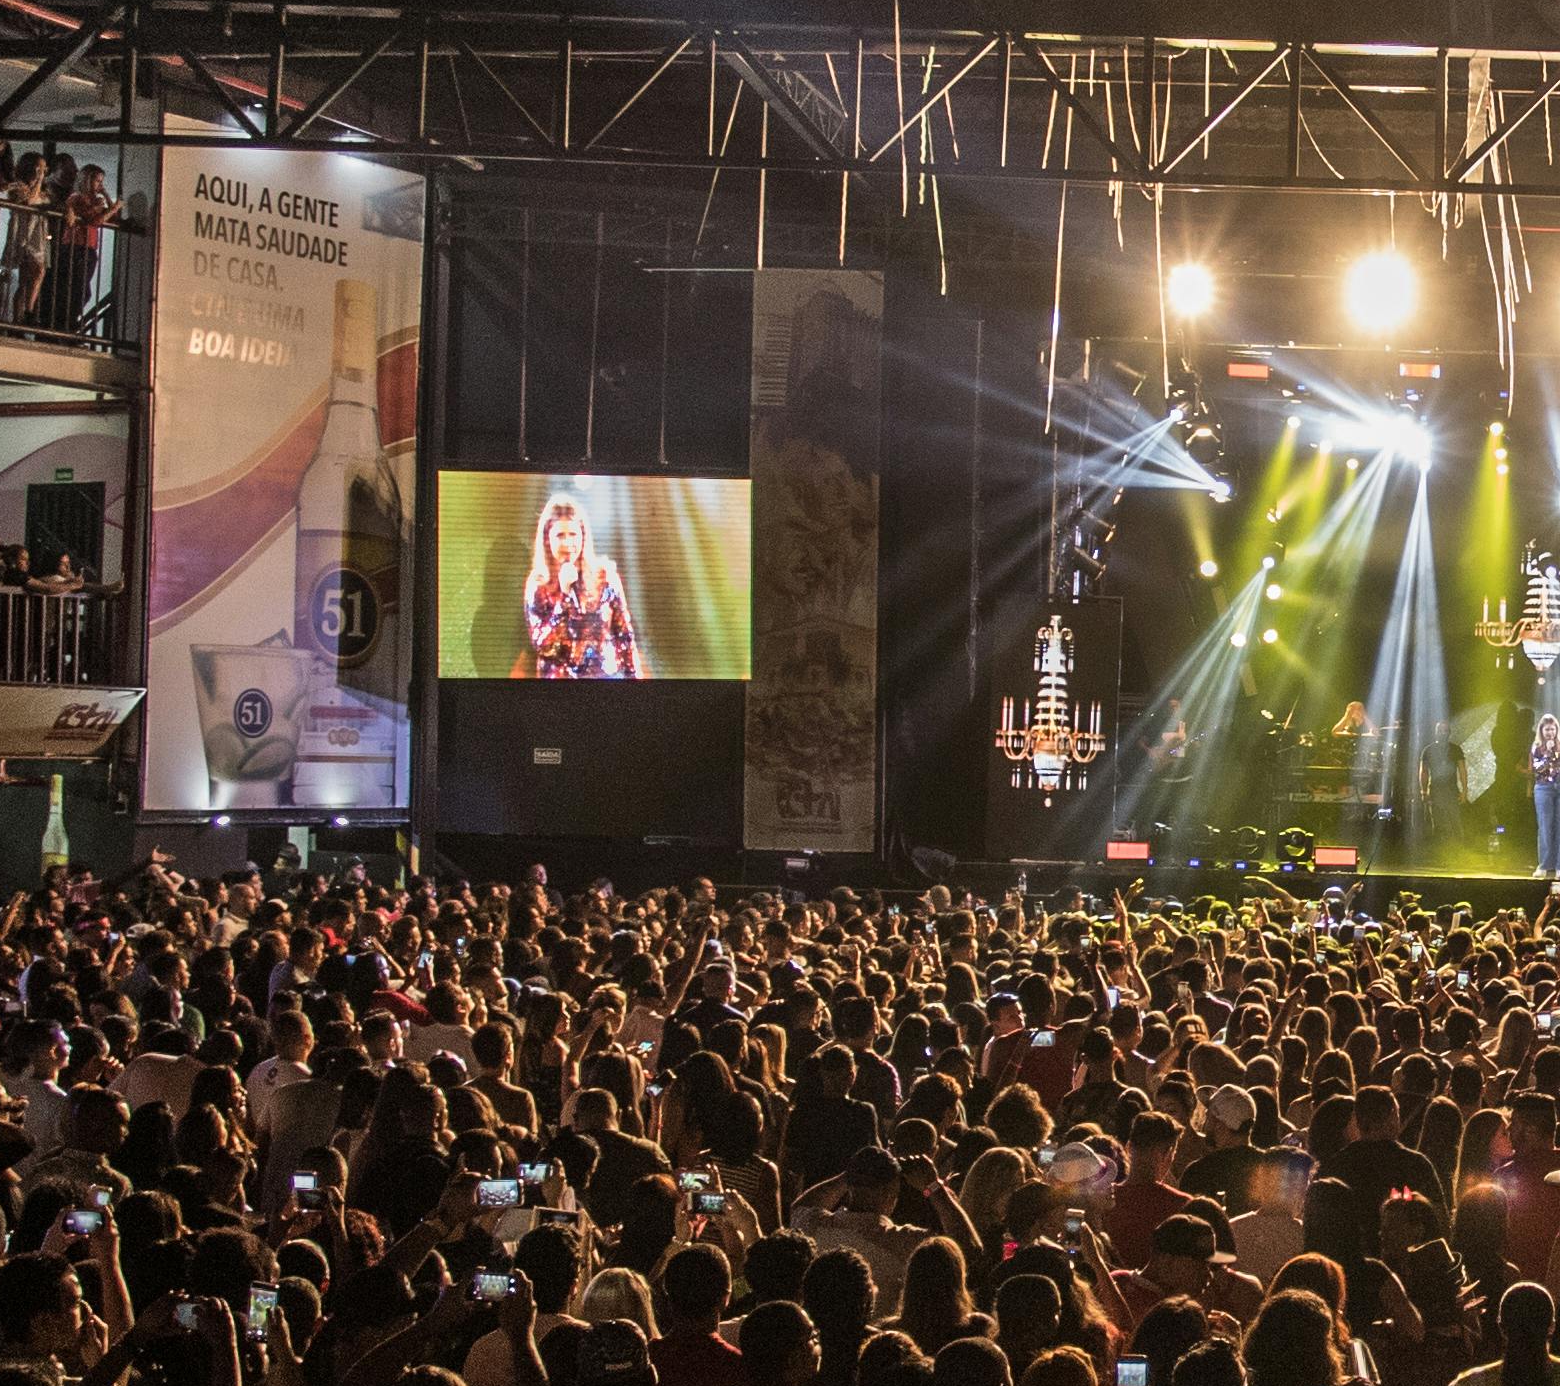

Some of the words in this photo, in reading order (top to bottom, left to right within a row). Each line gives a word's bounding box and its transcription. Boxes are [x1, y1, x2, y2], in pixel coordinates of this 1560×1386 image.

[194, 173, 254, 214] AQUI,
[258, 188, 272, 214] A
[278, 191, 339, 228] GENTE
[195, 211, 251, 247] MATA
[256, 224, 348, 267] SAUDADE
[194, 250, 220, 279] DE
[227, 256, 284, 292] CASA.
[254, 299, 305, 332] UMA
[188, 327, 235, 359] BOA
[240, 336, 299, 368] IDEIA
[321, 588, 366, 638] 51
[240, 701, 263, 725] 51
